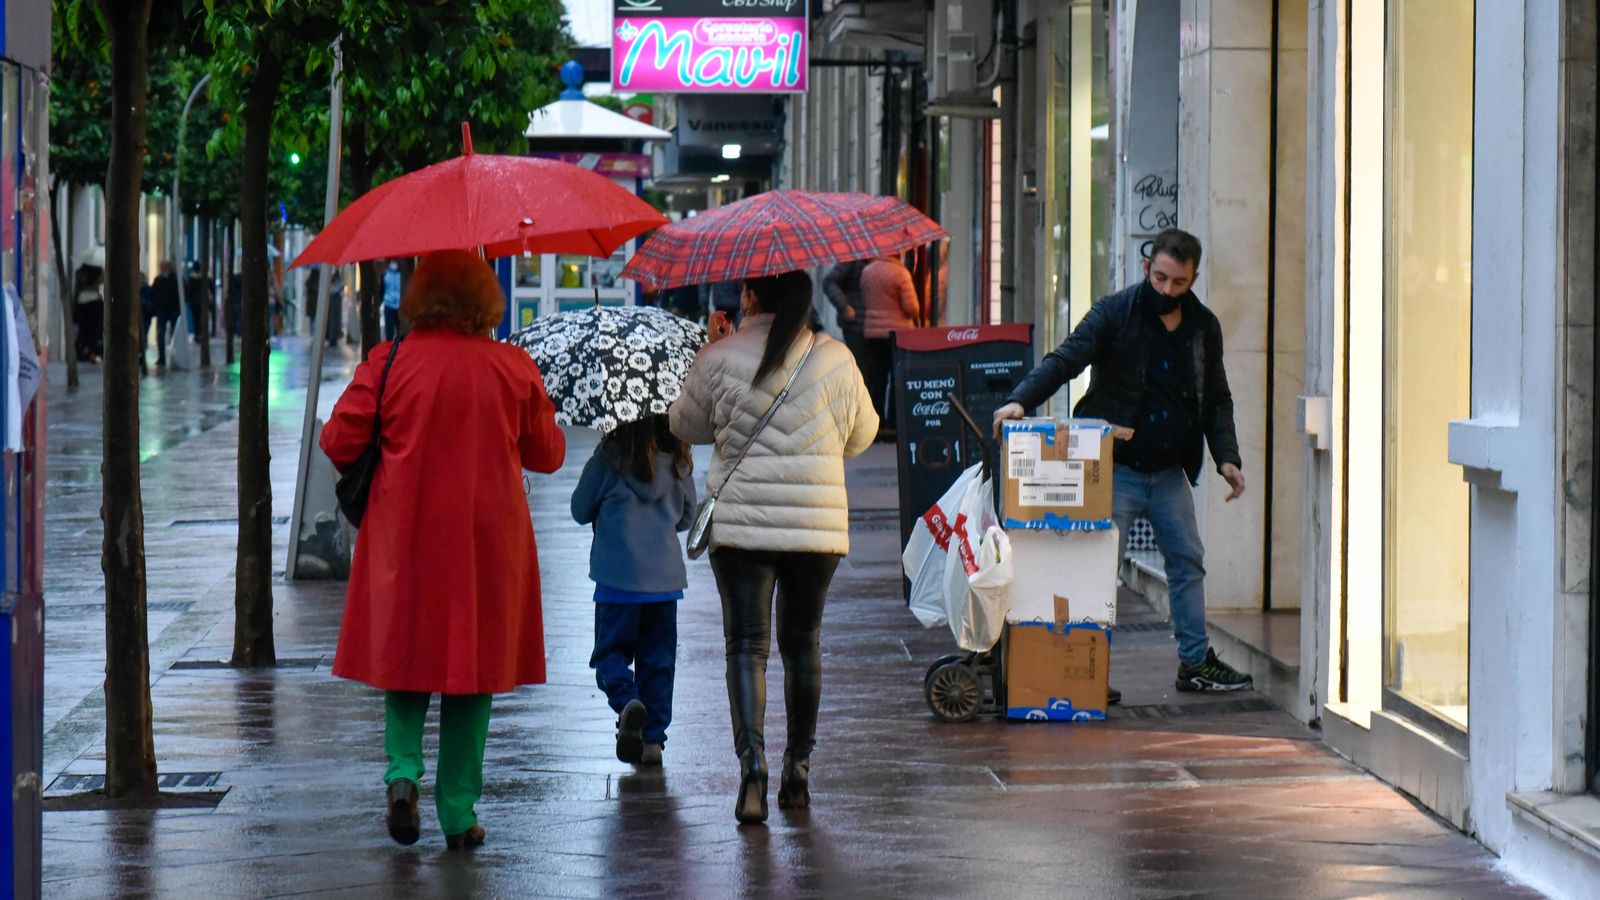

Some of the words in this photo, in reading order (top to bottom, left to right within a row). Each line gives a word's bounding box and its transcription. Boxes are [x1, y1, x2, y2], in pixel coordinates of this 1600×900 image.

[619, 20, 803, 87] Mavil
[906, 380, 921, 390] TU
[923, 377, 955, 390] MENÚ
[920, 390, 943, 400] CON
[925, 419, 942, 427] POR
